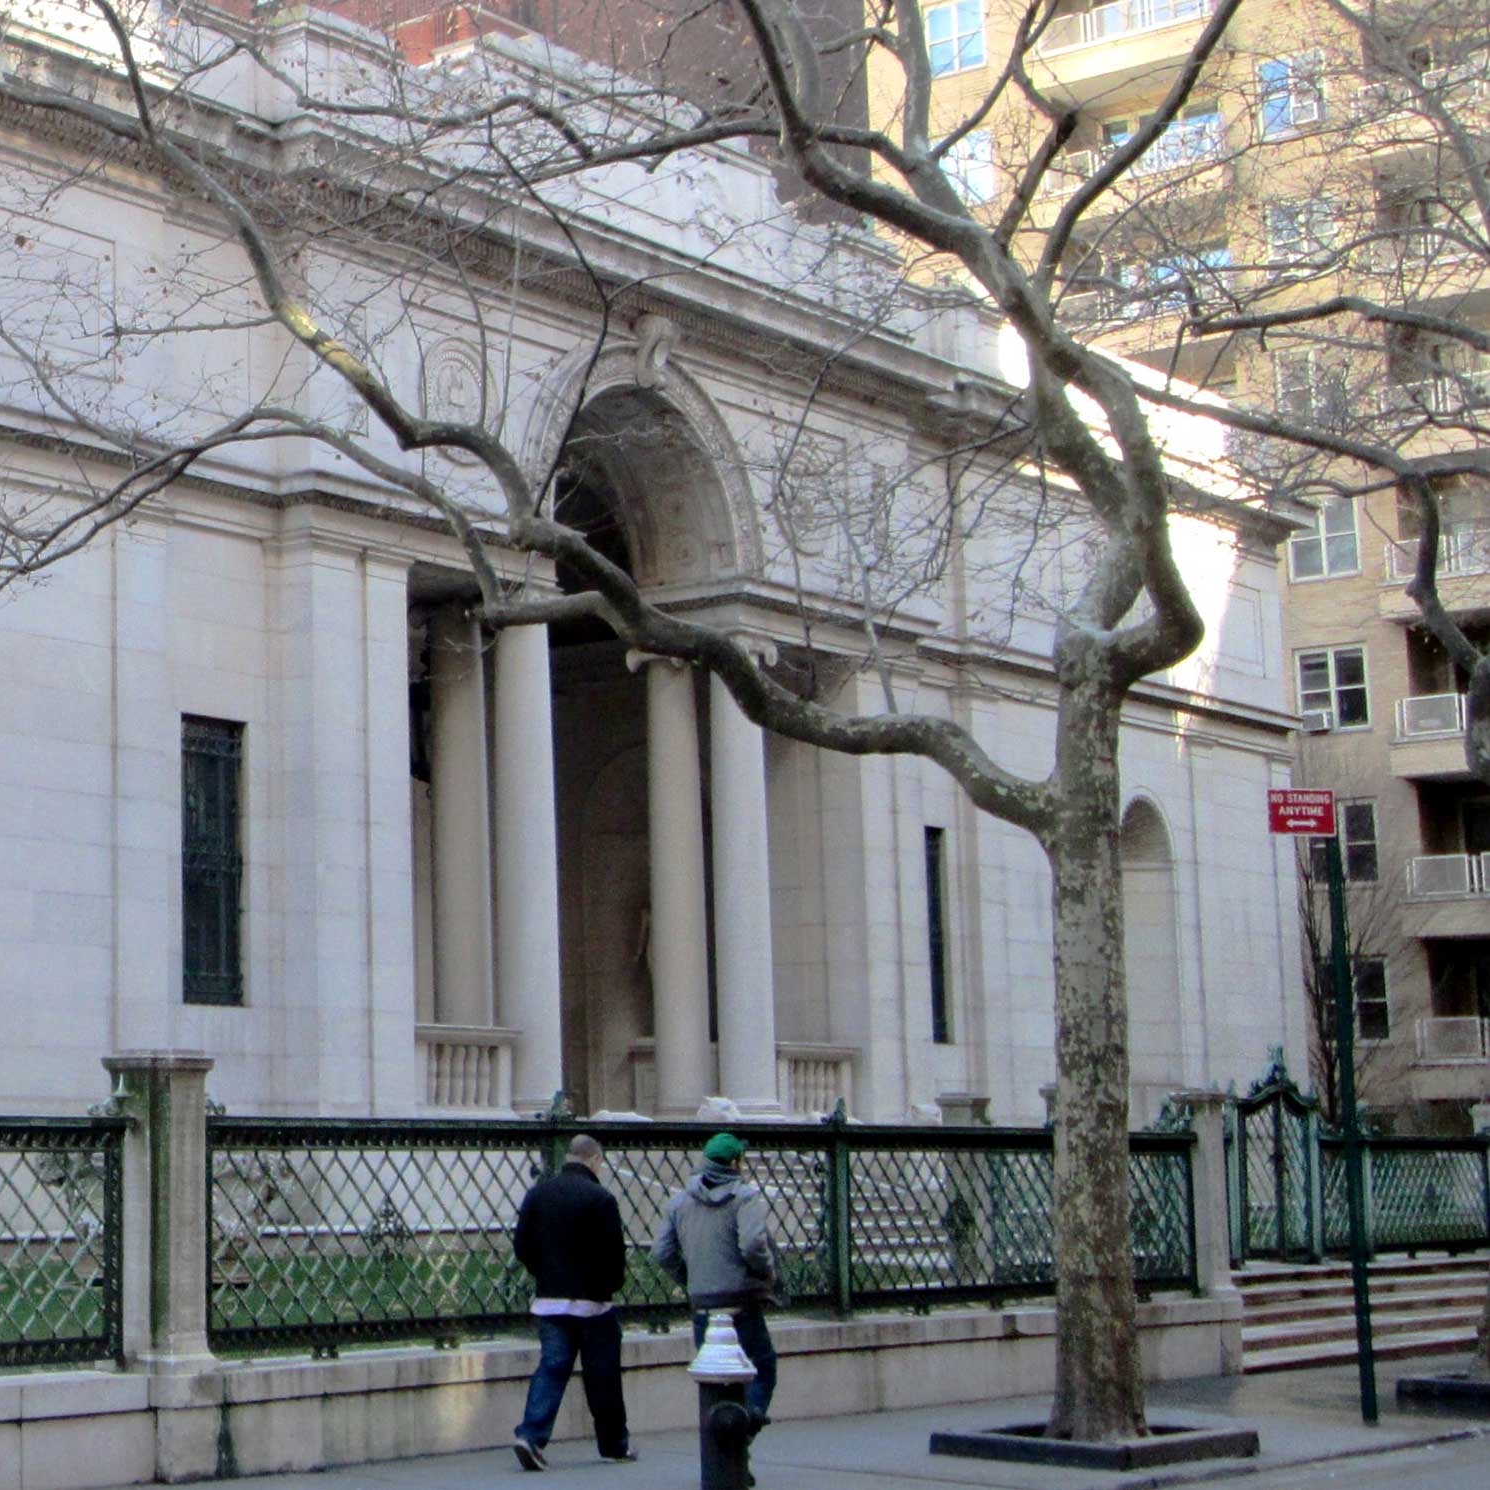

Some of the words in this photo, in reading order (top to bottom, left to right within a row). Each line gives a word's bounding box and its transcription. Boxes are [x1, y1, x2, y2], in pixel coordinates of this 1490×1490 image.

[1270, 793, 1284, 803] NO
[1287, 793, 1330, 804] STANDING
[1278, 806, 1324, 816] ANYTIME
